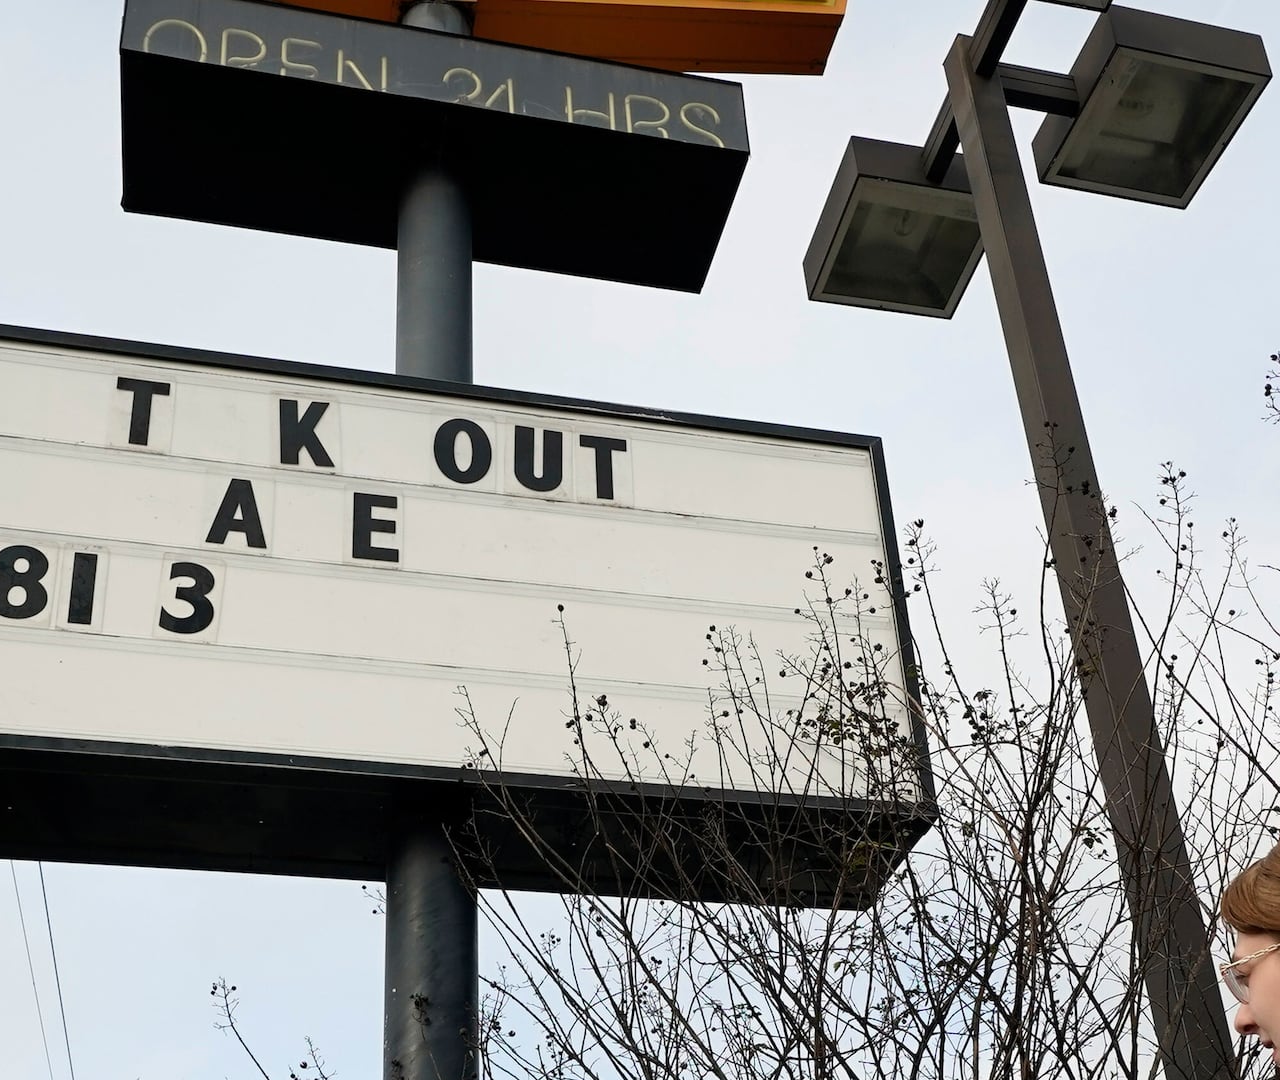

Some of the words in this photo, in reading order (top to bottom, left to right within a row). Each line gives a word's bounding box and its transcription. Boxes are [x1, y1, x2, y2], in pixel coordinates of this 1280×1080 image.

[116, 376, 171, 446] T
[279, 398, 336, 468] K
[433, 418, 628, 500] OUT
[205, 478, 267, 549] A
[352, 492, 399, 563] E
[158, 561, 216, 635] 3
